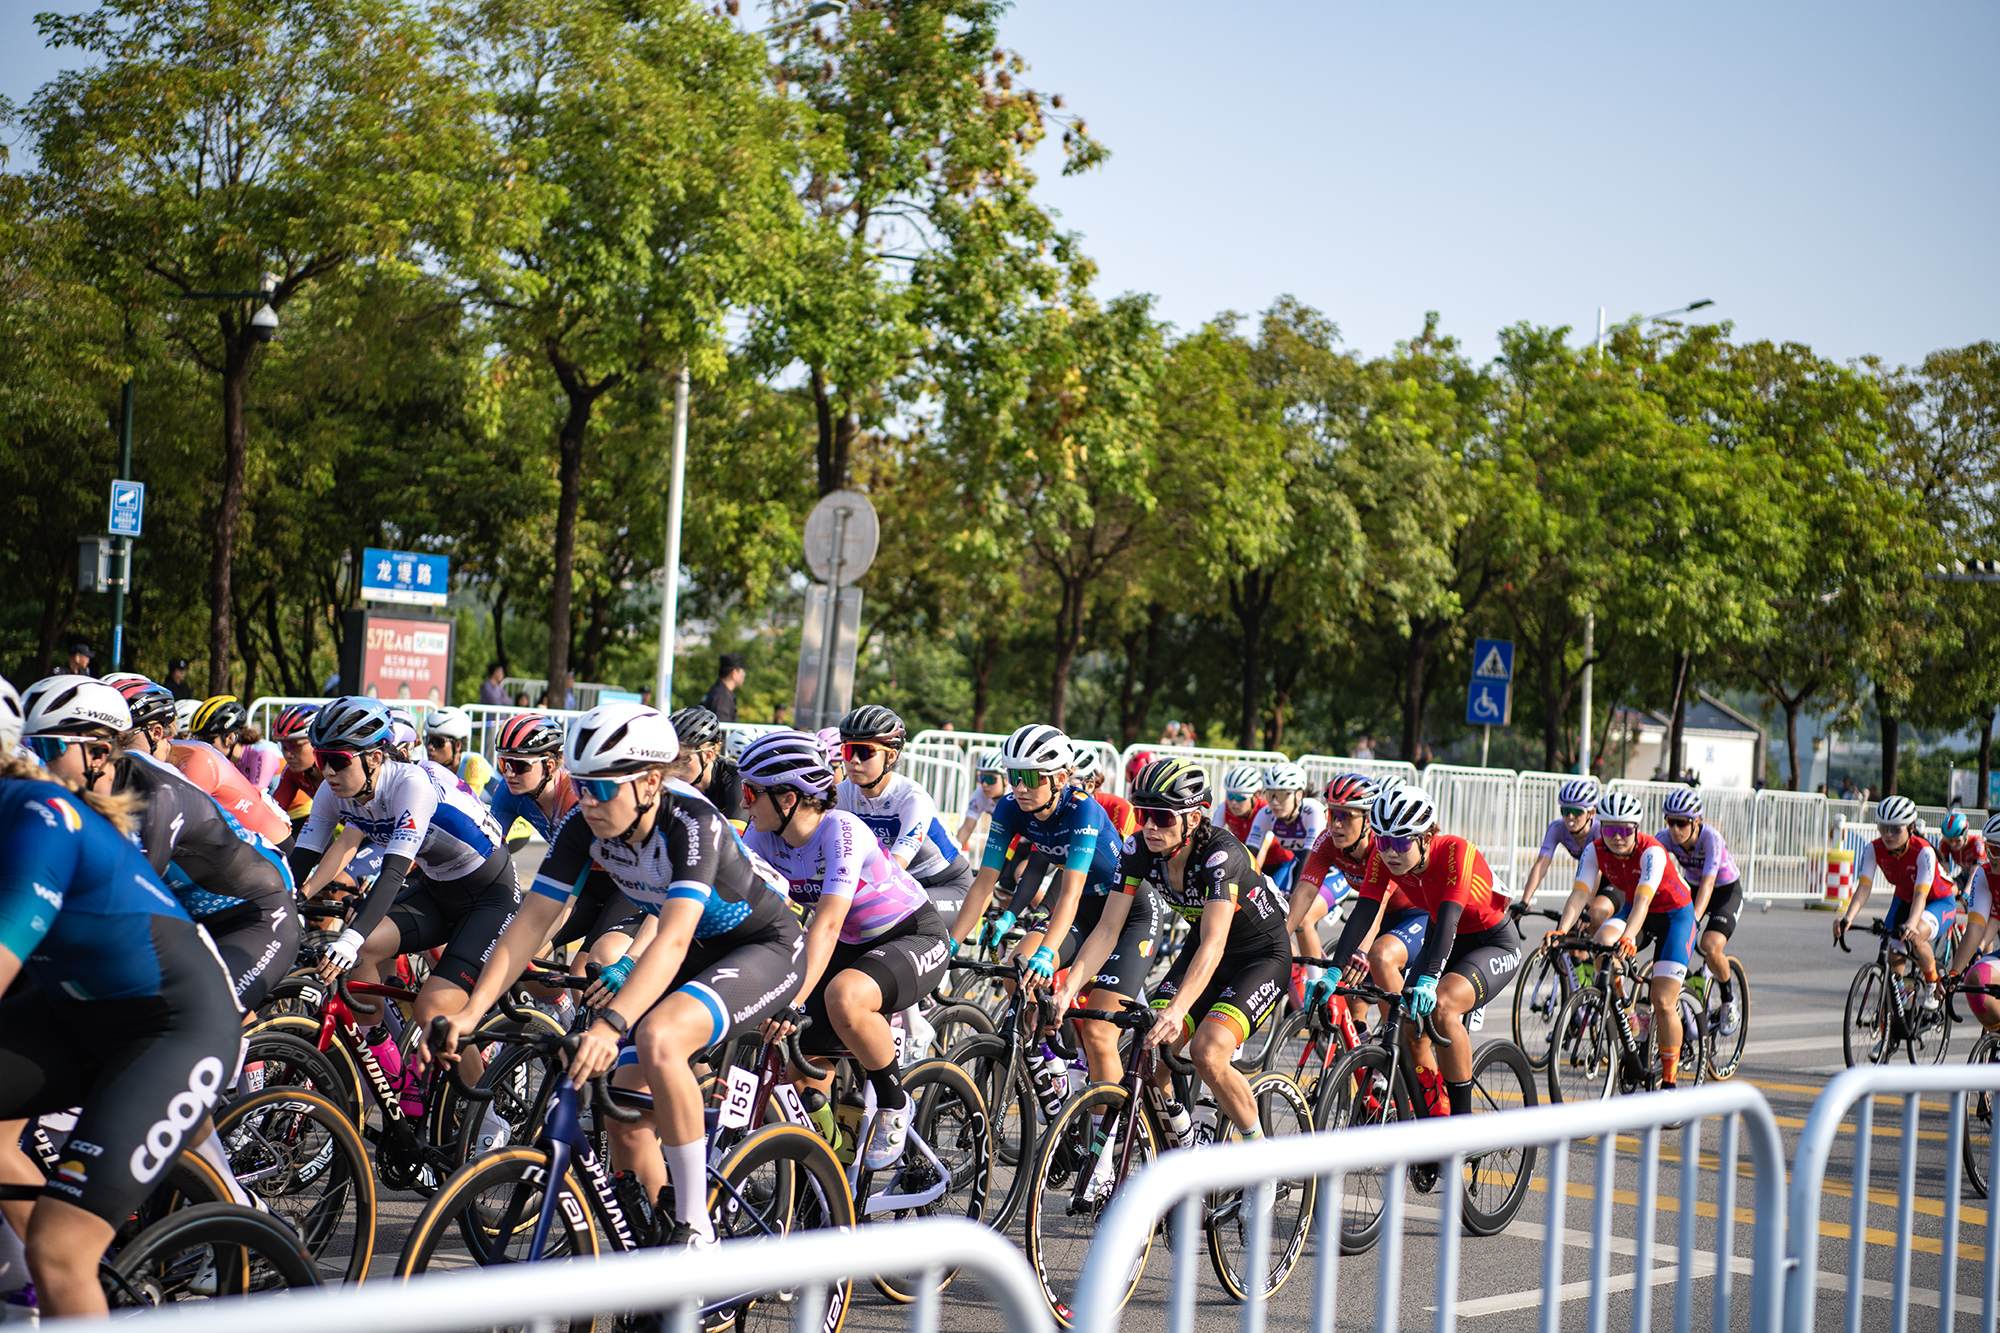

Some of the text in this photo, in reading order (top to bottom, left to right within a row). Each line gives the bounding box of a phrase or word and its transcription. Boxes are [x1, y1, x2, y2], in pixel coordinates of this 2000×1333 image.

[72, 706, 125, 728] S-WORKS
[626, 747, 672, 759] S-WORKS
[775, 772, 794, 782] ABUS
[545, 803, 582, 859] VolkerWes
[840, 818, 852, 858] LABORAL
[789, 883, 822, 894] ABOR
[1301, 874, 1319, 884] OGEAS
[1147, 891, 1159, 936] REPSOL
[235, 939, 282, 996] erWessels
[1489, 947, 1522, 976] CHINA
[733, 971, 798, 1024] VolkerWessels
[1245, 979, 1275, 1010] BTC City
[344, 1021, 405, 1121] S-WORKS
[241, 1101, 316, 1124] roval
[730, 1079, 750, 1118] 155
[130, 1055, 224, 1184] coop
